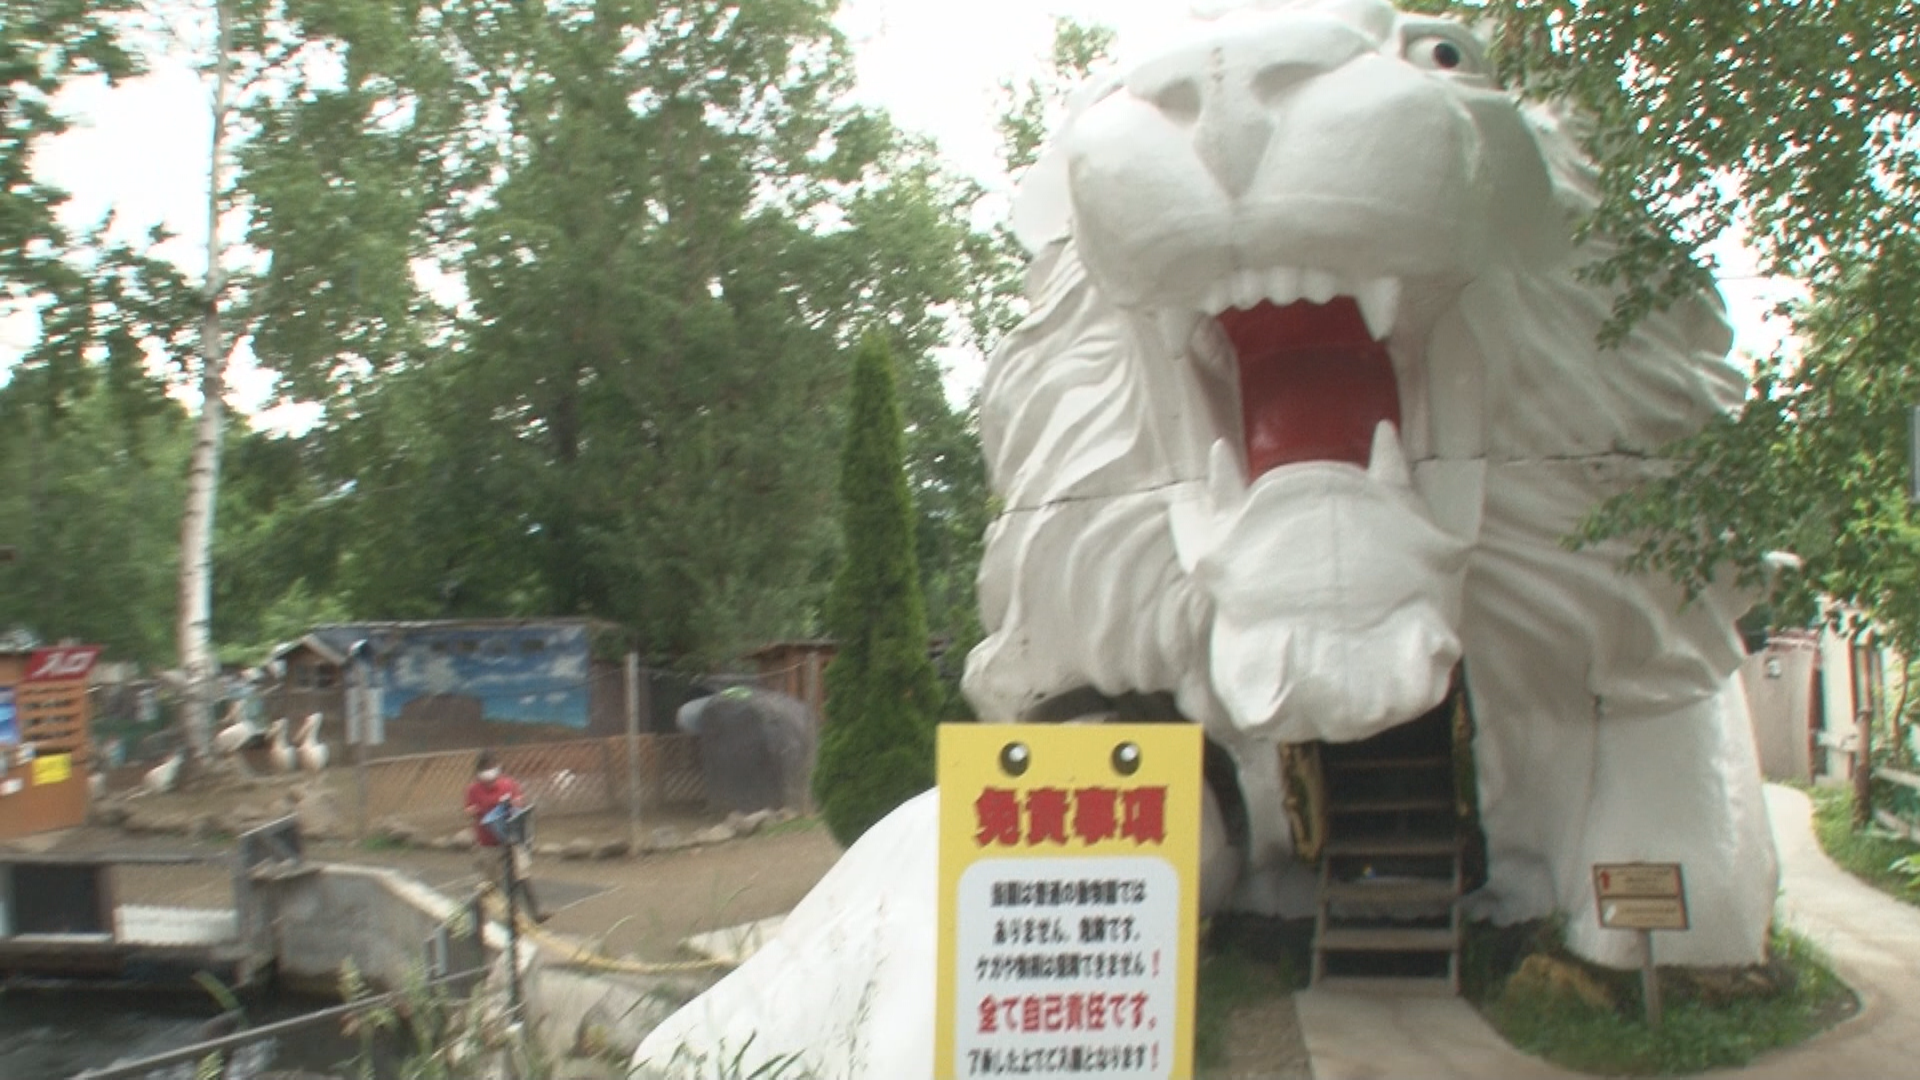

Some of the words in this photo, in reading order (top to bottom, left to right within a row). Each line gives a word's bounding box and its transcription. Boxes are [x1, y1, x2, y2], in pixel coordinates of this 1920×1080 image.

[974, 786, 1167, 847] 免責事項
[977, 992, 1157, 1033] 全て自己責任です。
